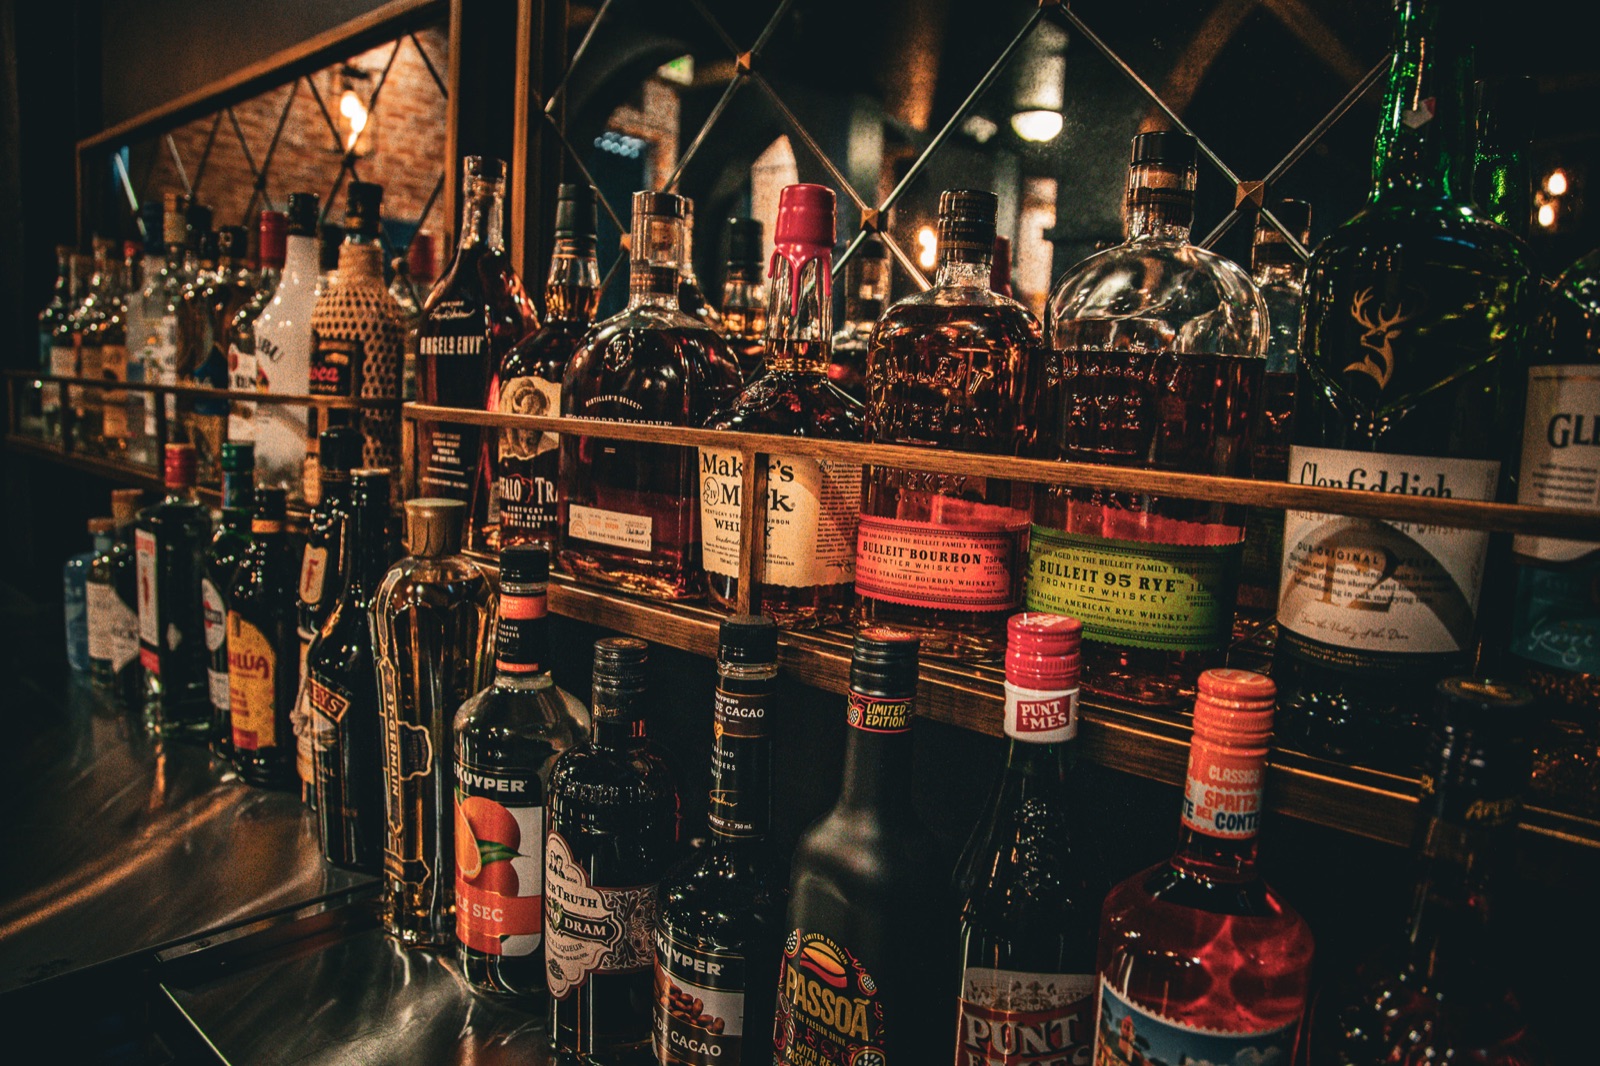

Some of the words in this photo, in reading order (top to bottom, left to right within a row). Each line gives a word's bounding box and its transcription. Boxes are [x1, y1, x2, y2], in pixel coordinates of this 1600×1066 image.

[456, 336, 482, 355] ENVY
[702, 453, 794, 483] Makr's
[863, 541, 904, 558] BULLEIT
[910, 548, 981, 564] BOURBON
[942, 541, 967, 549] FAMILY
[1317, 546, 1378, 565] ORIGINAL
[868, 555, 910, 567] FRONTIER
[915, 563, 967, 573] WHISKEY
[1054, 551, 1071, 560] AGED
[1082, 556, 1097, 565] THE
[1099, 559, 1133, 569] BULLEIT
[1136, 563, 1169, 573] FAMILY
[879, 570, 912, 580] STRAIGHT
[915, 576, 954, 585] BOURBON
[1040, 560, 1099, 583] BULLEIT
[1104, 572, 1132, 587] 95
[1139, 576, 1176, 593] RYE
[1041, 576, 1096, 594] FRONTIER
[1102, 588, 1168, 603] WHISKEY
[1355, 592, 1371, 600] oak
[1031, 589, 1062, 603] STRAIGHT
[1065, 599, 1111, 613] AMERICAN
[1115, 607, 1135, 616] RYE
[1140, 611, 1190, 621] WHISKEY
[725, 705, 765, 718] CACAO
[866, 703, 906, 716] LIMITED
[1020, 700, 1061, 717] PUNT
[865, 714, 906, 728] EDITION
[1030, 713, 1067, 730] MES
[457, 763, 526, 793] KUYPER
[1204, 790, 1258, 813] SPRITZ
[1195, 804, 1214, 821] DEL
[1215, 812, 1259, 831] CONTE
[557, 885, 598, 909] TRUTH
[472, 903, 503, 923] SEC
[564, 917, 606, 936] DRAM
[656, 930, 722, 977] KUYPER
[801, 932, 825, 943] LIMITED
[826, 937, 849, 966] EDITION
[785, 963, 871, 1042] PASSOÃ
[806, 1017, 828, 1037] PASSION
[828, 1031, 846, 1047] DRINK
[963, 1013, 1079, 1055] PUNT
[670, 1030, 722, 1057] CACAO
[796, 1041, 818, 1061] WITH
[785, 1046, 817, 1066] PASSIO
